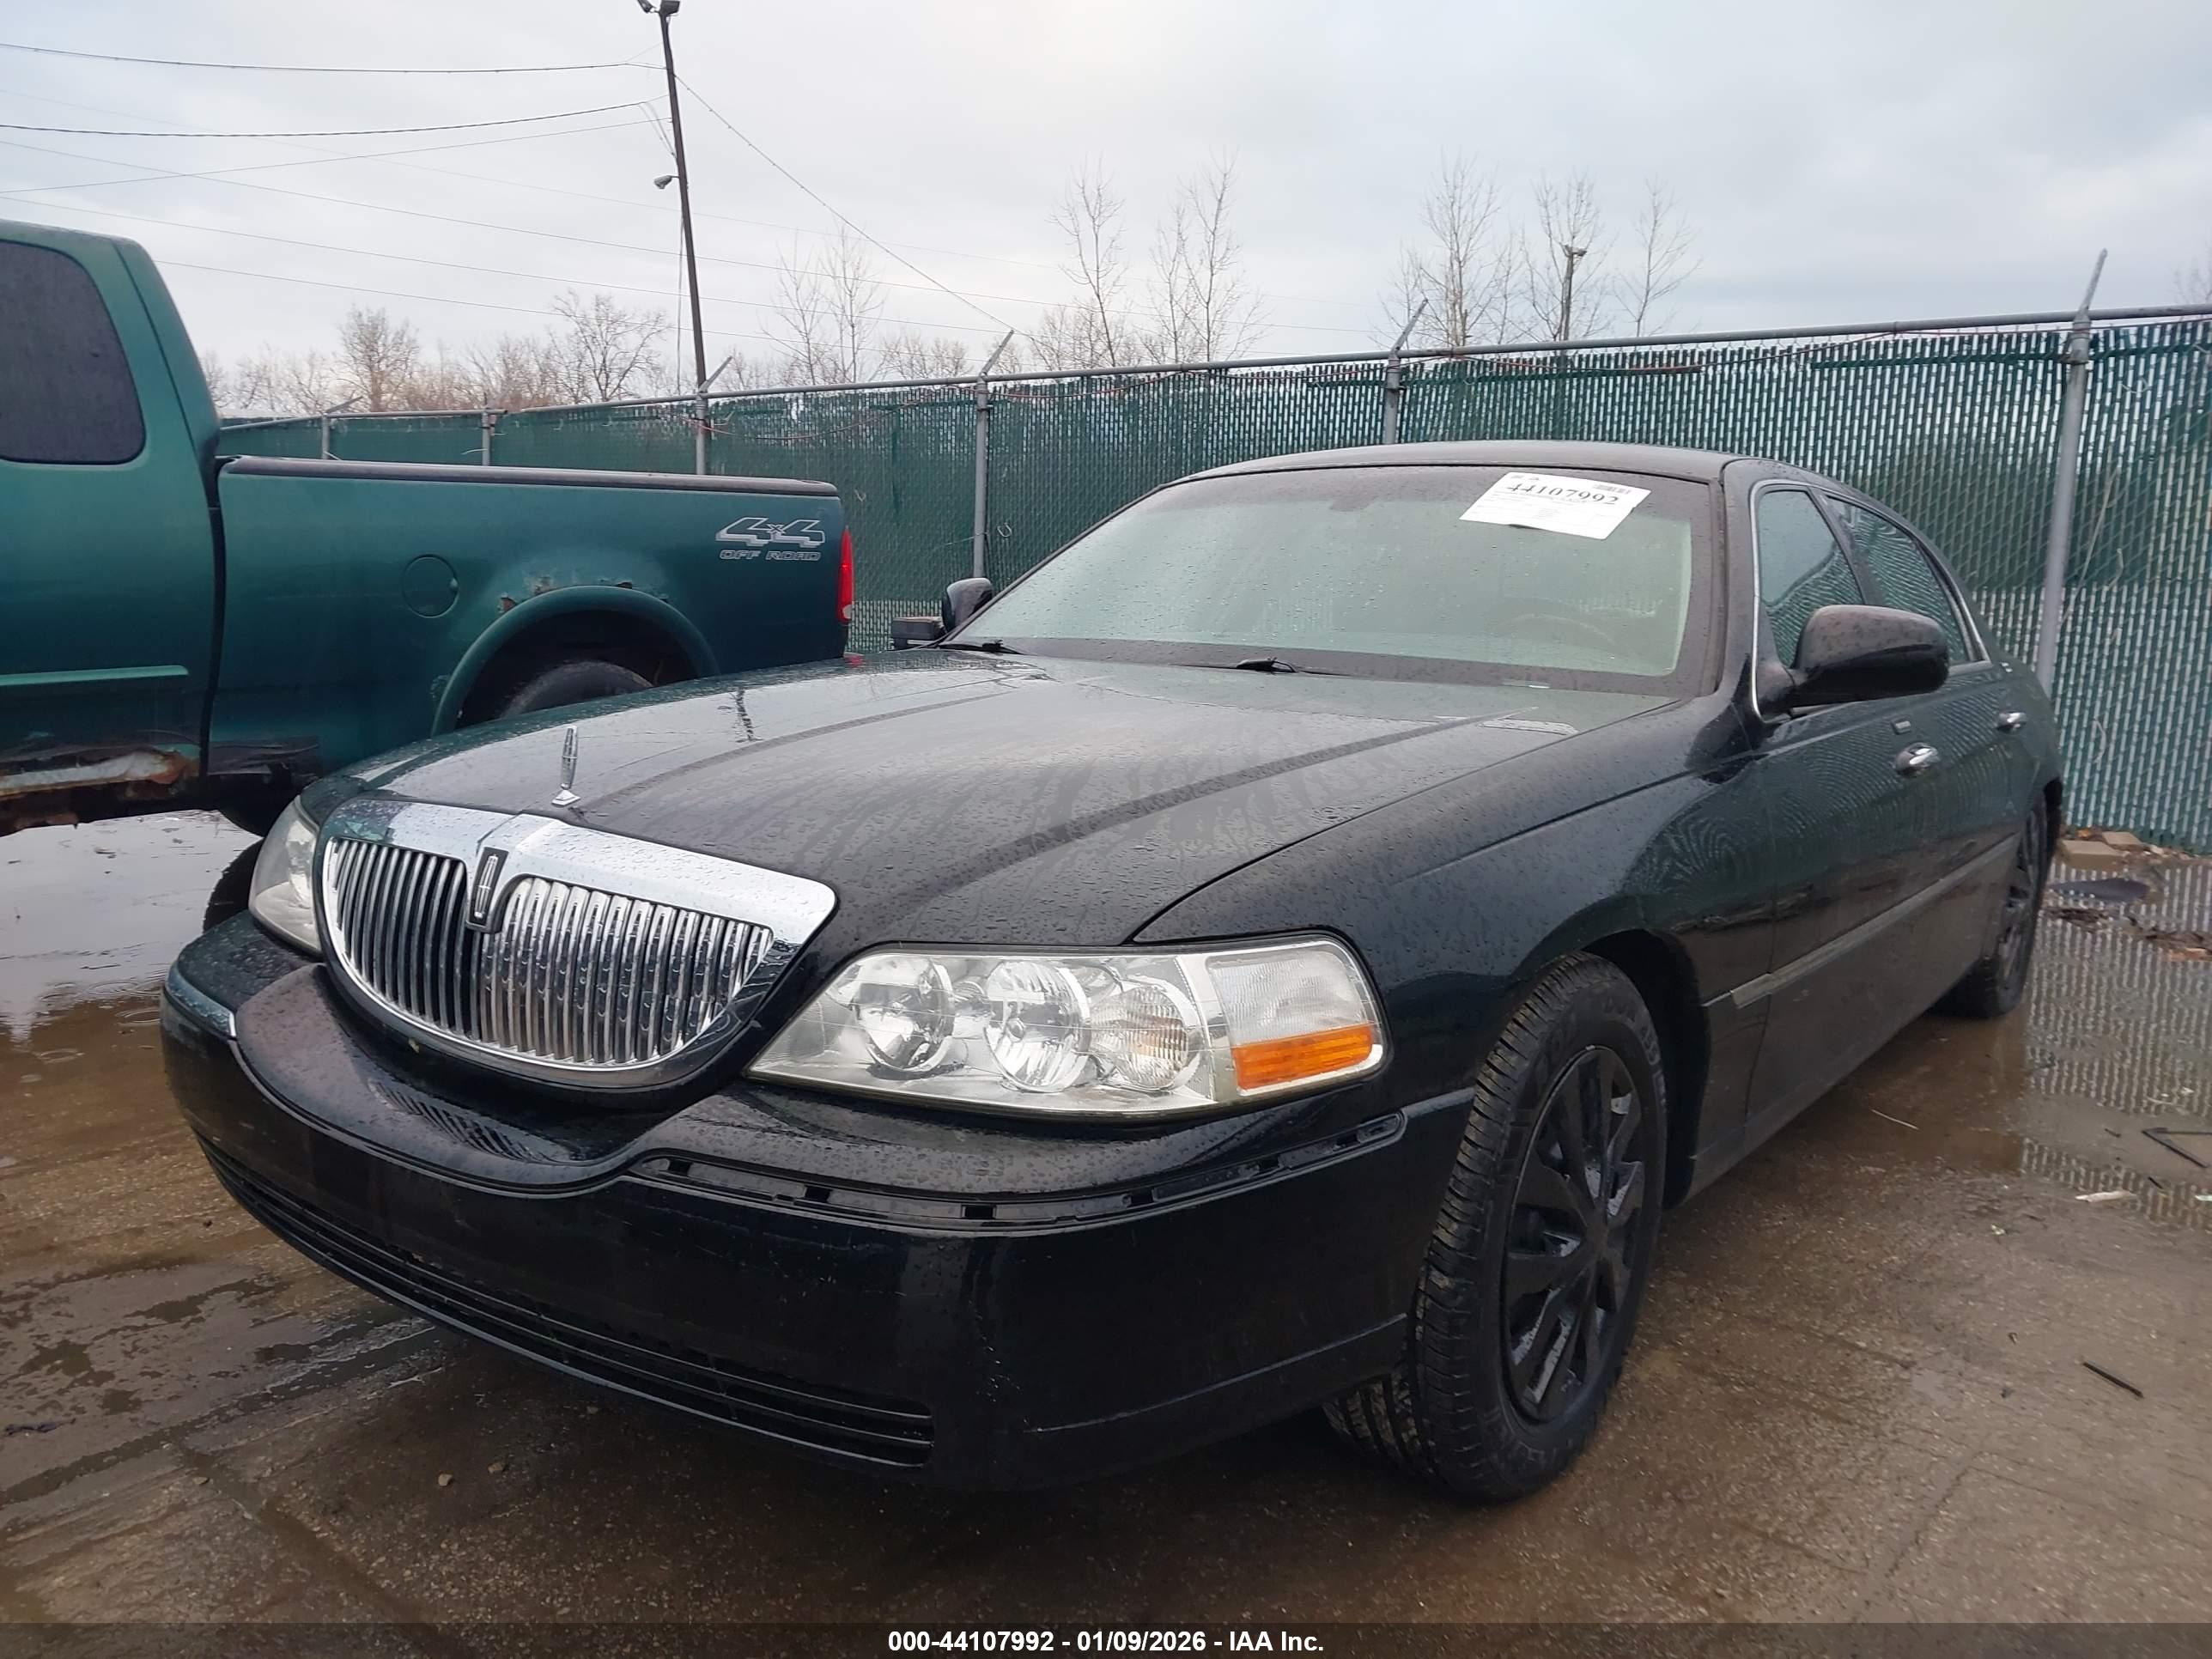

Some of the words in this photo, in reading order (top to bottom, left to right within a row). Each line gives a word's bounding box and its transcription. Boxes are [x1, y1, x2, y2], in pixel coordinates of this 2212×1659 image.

[1506, 483, 1620, 504] 44107992
[720, 550, 762, 561] OFF
[765, 550, 822, 562] ROAD
